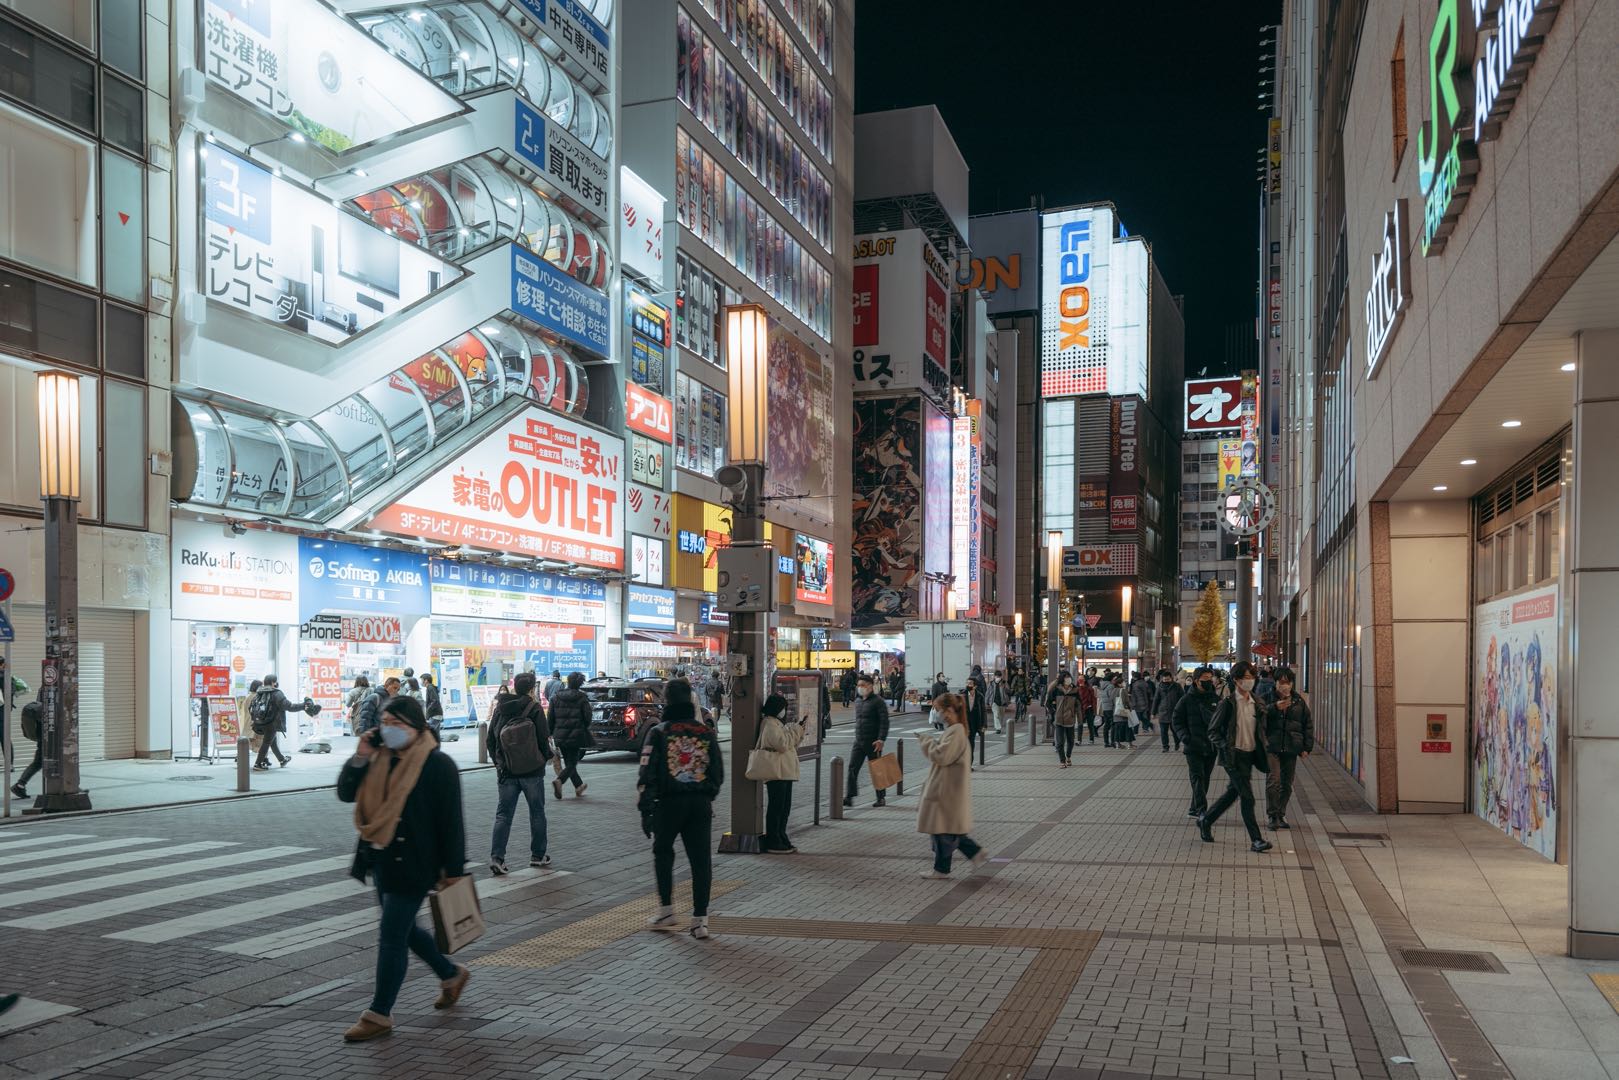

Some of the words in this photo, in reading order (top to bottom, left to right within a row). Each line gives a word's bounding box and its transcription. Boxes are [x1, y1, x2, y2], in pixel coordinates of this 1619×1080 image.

[207, 12, 278, 81] 洗濯機
[549, 6, 608, 77] 中古専門店
[209, 50, 294, 116] エアコン
[1475, 0, 1541, 142] Akiha
[522, 113, 539, 155] 2F
[217, 160, 257, 220] 3F
[209, 234, 274, 283] テレビ
[211, 267, 314, 321] レコーダー
[516, 277, 587, 337] 修理・ご相談
[630, 391, 670, 434] アコム
[1120, 401, 1137, 435] Duty
[563, 457, 580, 470] だから
[1120, 438, 1137, 472] Free
[452, 472, 503, 513] 家電の
[499, 459, 617, 538] OUTLET
[679, 530, 706, 554] 世界の
[245, 556, 293, 575] STATION
[327, 559, 380, 586] Sofmap
[385, 569, 423, 587] AKIBA
[434, 567, 445, 579] B1
[500, 573, 511, 586] 2F
[529, 576, 540, 589] 3F
[556, 580, 567, 593] 4F
[582, 583, 592, 595] 5F
[504, 631, 526, 647] Tax
[528, 633, 552, 648] Free
[311, 661, 338, 679] Tax
[311, 679, 340, 695] Free
